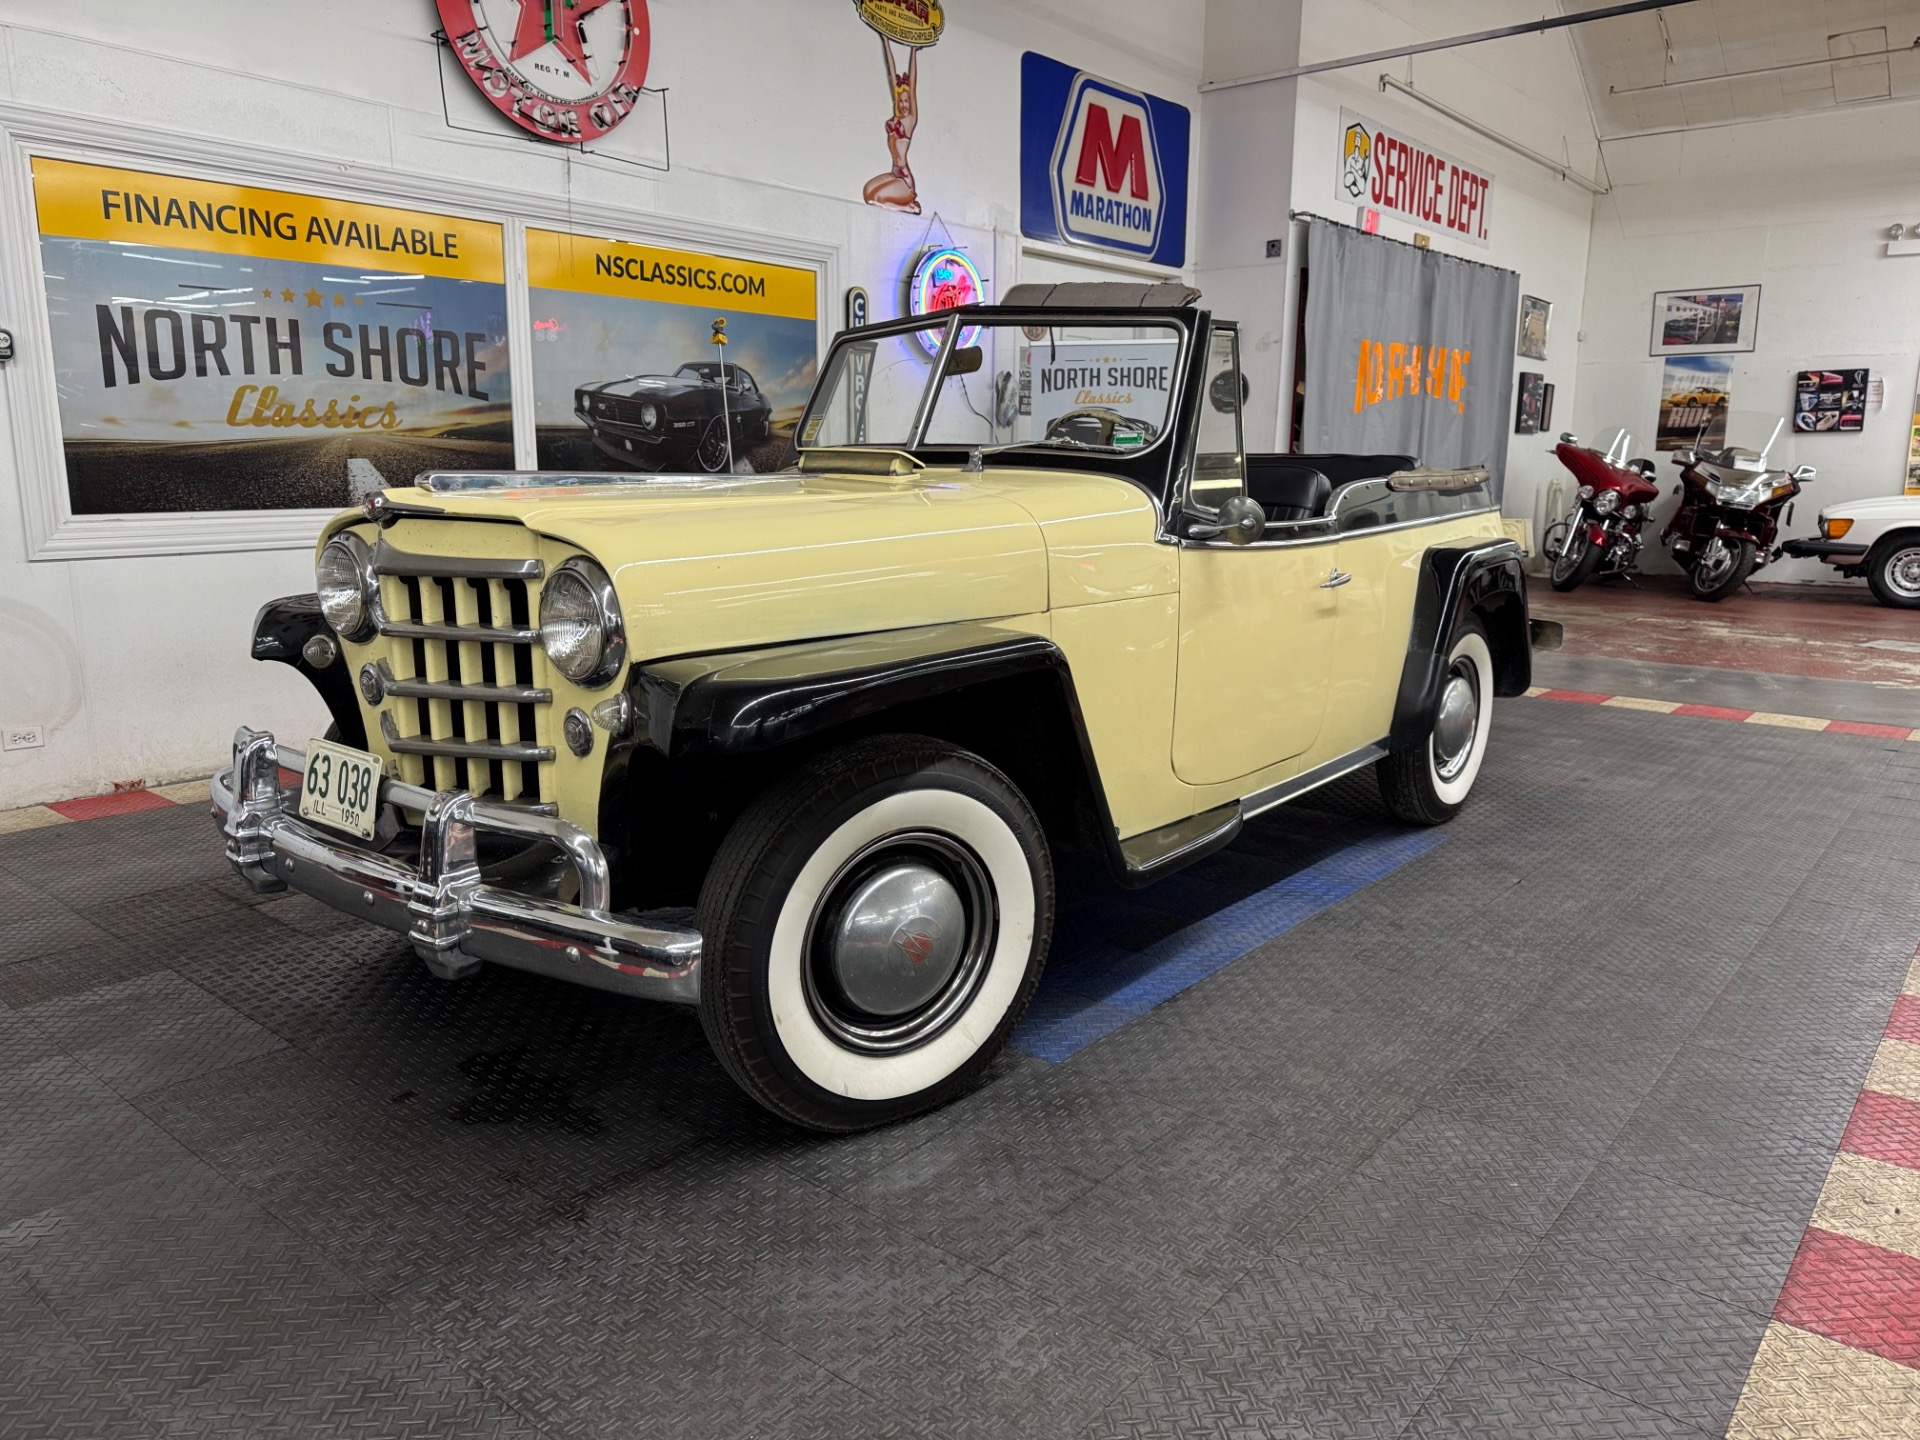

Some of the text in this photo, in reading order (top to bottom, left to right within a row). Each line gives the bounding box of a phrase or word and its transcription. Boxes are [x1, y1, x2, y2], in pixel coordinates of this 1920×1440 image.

[874, 3, 887, 14] PARTS
[889, 9, 897, 17] AND
[455, 30, 581, 138] MOTOR
[1371, 131, 1489, 240] SERVICE DEPT.
[100, 189, 459, 260] FINANCING AVAILABLE
[1070, 189, 1152, 233] MARATHON
[595, 253, 765, 297] NSCLASSICS.COM
[95, 303, 489, 402] NORTH SHORE
[1040, 366, 1168, 394] NORTH SHORE
[1073, 389, 1133, 405] Classics
[226, 384, 404, 430] Classics
[307, 752, 372, 813] 63 038
[313, 799, 360, 828] ILL 1950
